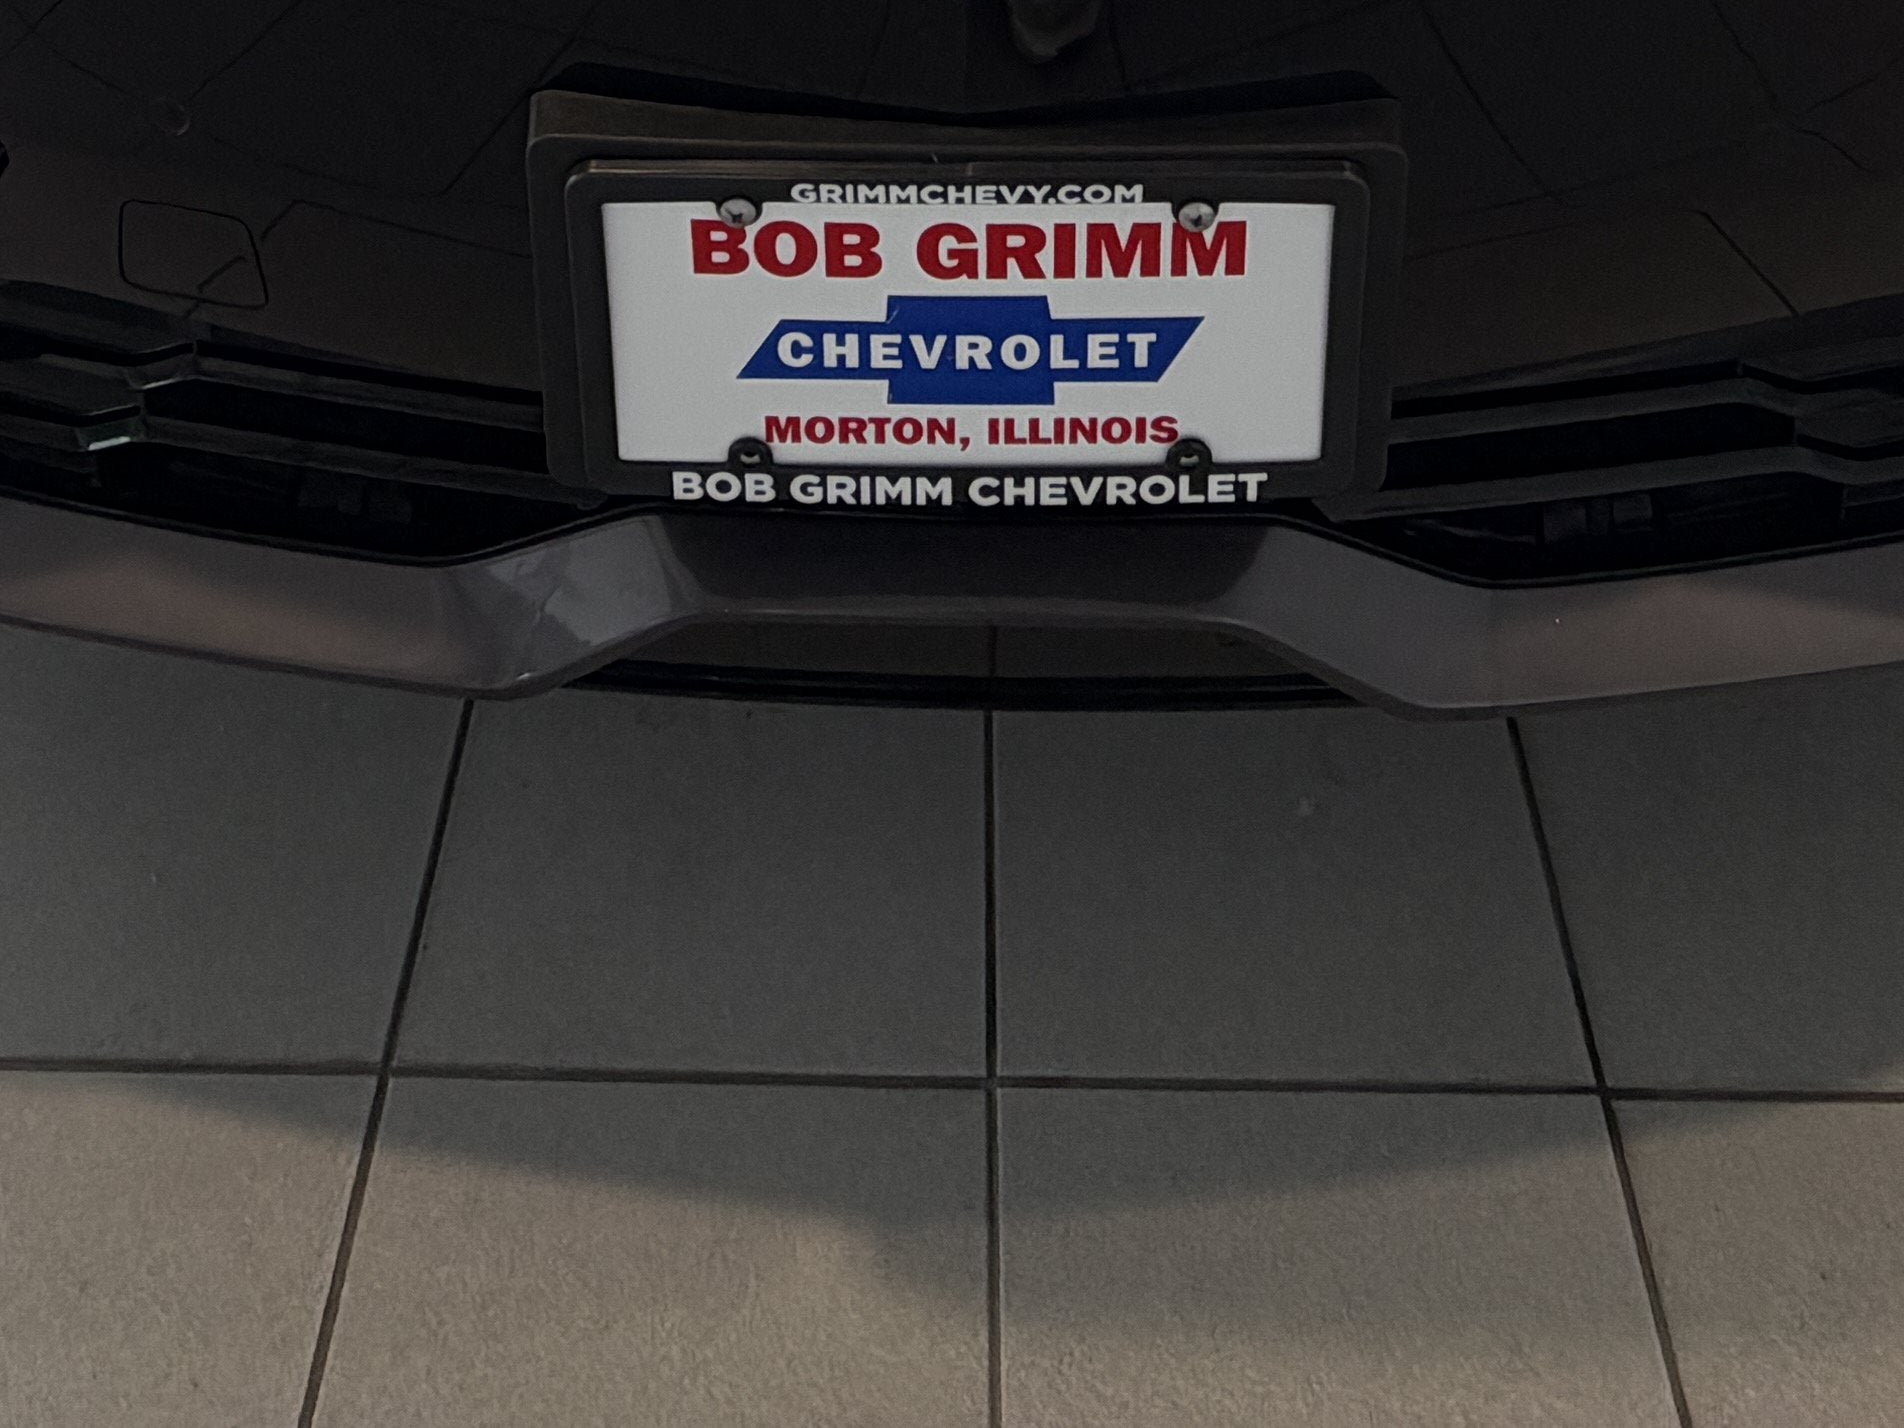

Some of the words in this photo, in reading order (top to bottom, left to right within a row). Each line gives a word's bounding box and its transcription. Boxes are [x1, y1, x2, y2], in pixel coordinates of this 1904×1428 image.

[790, 183, 1144, 206] GRIMMCHEVY.COM
[692, 218, 882, 279] BOB
[916, 219, 1247, 280] GRIMM
[776, 331, 1158, 372] CHEVROLET
[765, 416, 970, 451] MORTON,
[987, 416, 1178, 445] ILLINOIS
[672, 471, 778, 505] BOB
[789, 472, 953, 506] GRIMM
[967, 472, 1268, 506] CHEVROLET
